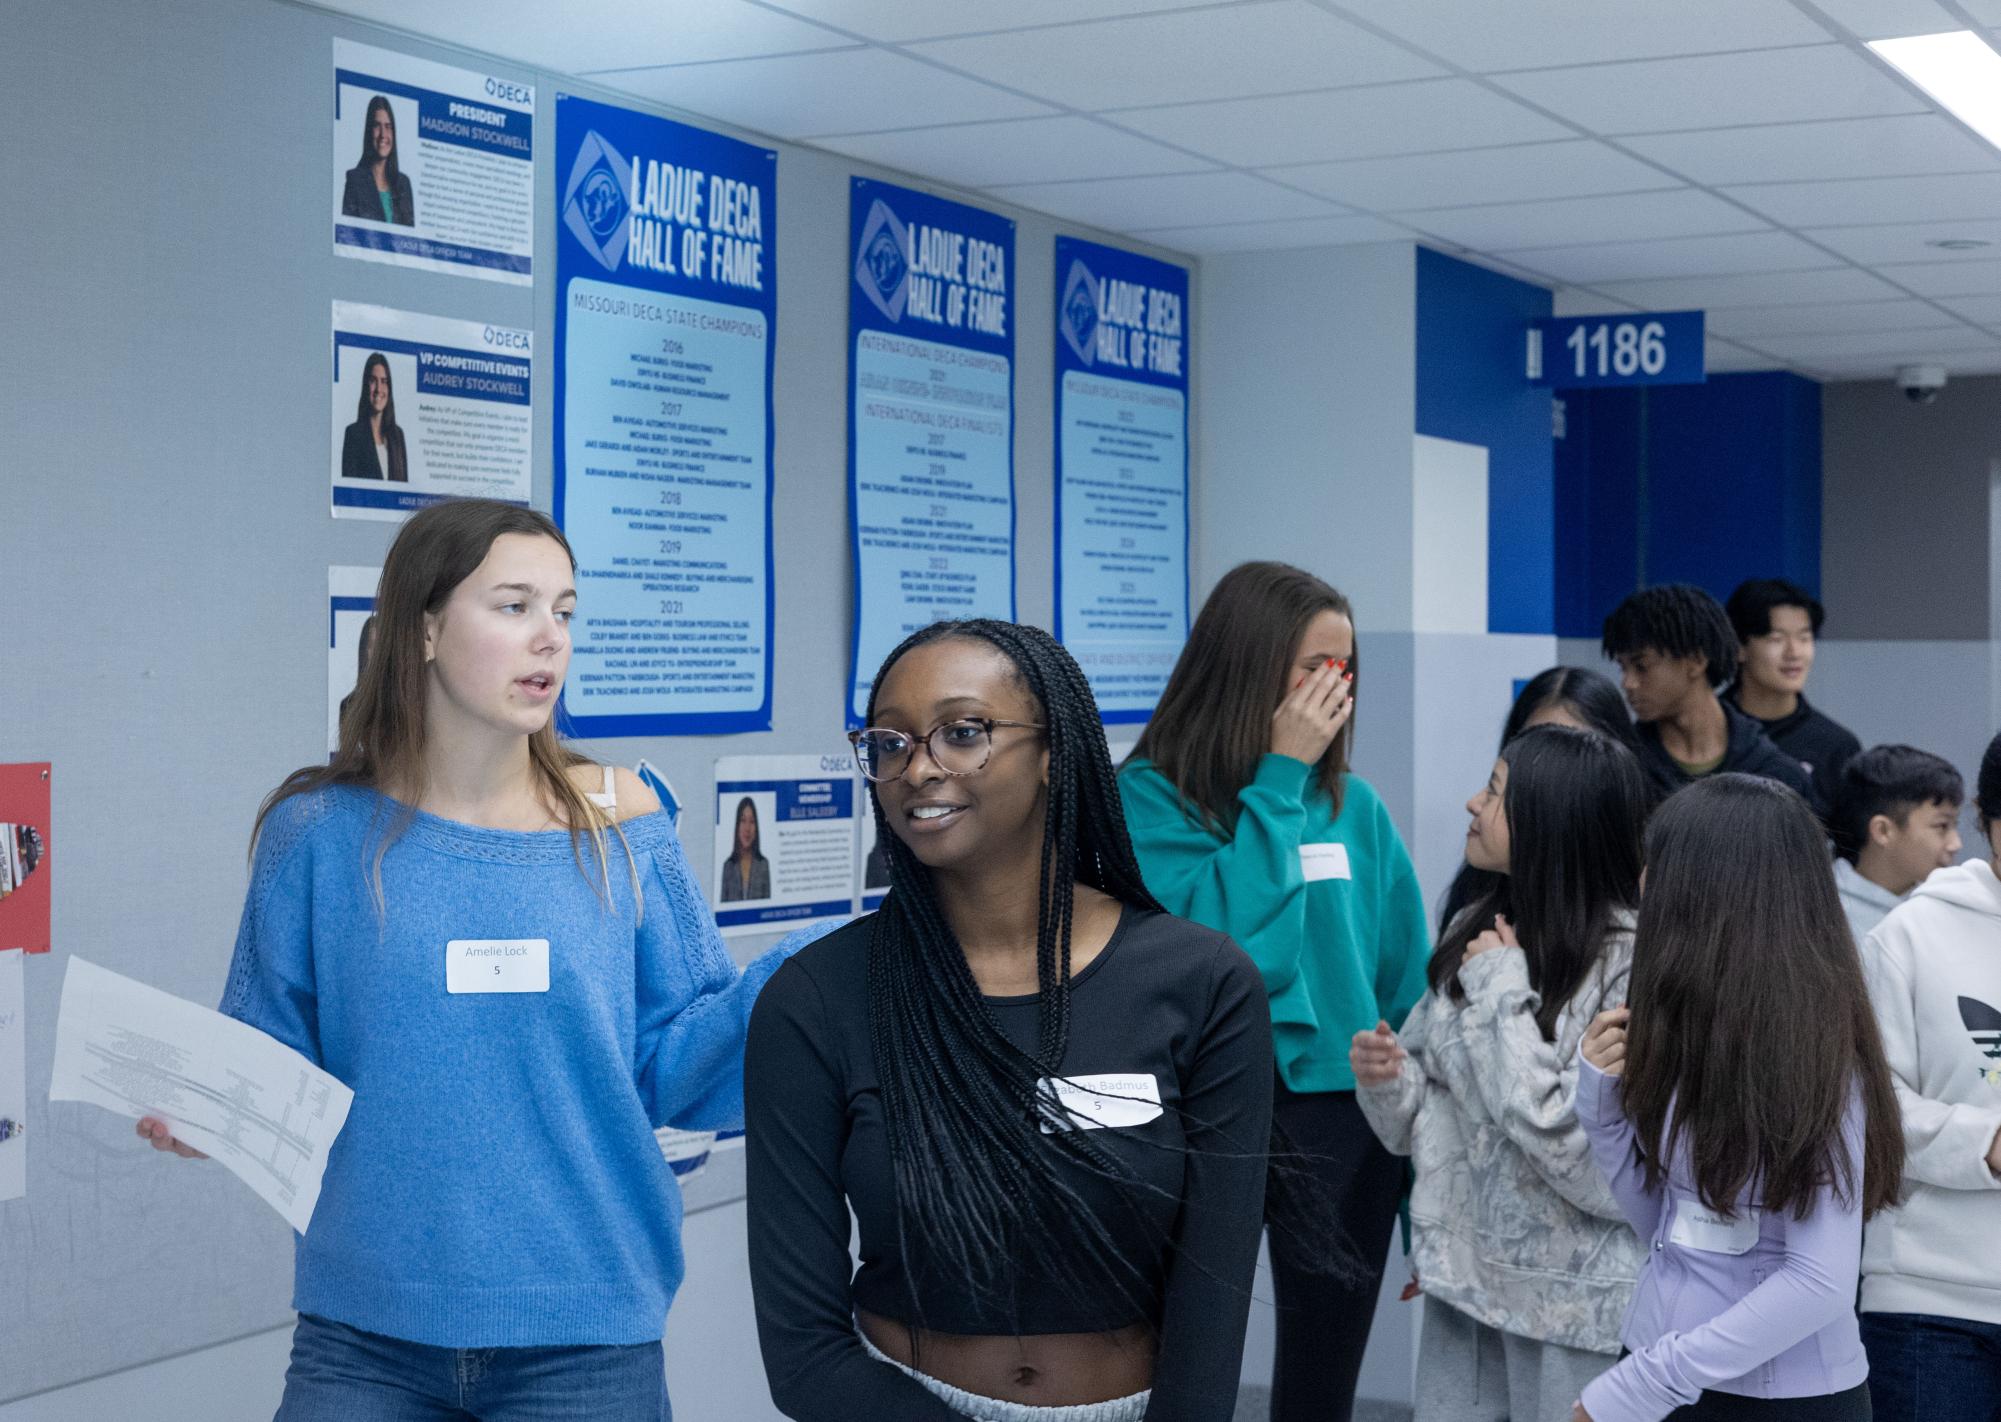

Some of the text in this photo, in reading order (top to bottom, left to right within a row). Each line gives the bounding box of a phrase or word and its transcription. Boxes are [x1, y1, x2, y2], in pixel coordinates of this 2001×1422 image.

[497, 84, 532, 105] DECA
[449, 102, 507, 127] PRESIDENT
[421, 116, 530, 151] MADISON STOCKWELL
[630, 155, 763, 241] LADUE DECA
[627, 215, 763, 292] HALL OF FAME
[907, 222, 1005, 295] LADUE DECA
[574, 294, 763, 340] MISSOURI DECA STATE CHAMPIONS
[907, 273, 1006, 338] HALL OF FAME
[1099, 276, 1182, 336] LADUE DECA
[496, 331, 530, 350] DECA
[662, 339, 684, 354] 2016
[1097, 322, 1182, 378] HALL OF FAME
[1567, 321, 1667, 378] 1186
[420, 352, 529, 379] VP COMPETITIVE EVENTS
[423, 372, 525, 397] AUDREY STOCKWELL
[661, 402, 683, 417] 2017
[660, 491, 682, 505] 2018
[660, 540, 682, 554] 2019
[660, 600, 683, 614] 2021
[465, 945, 528, 957] Amelie Lock
[494, 965, 501, 975] 5
[1100, 1080, 1149, 1091] Badmus
[1094, 1101, 1102, 1111] 5
